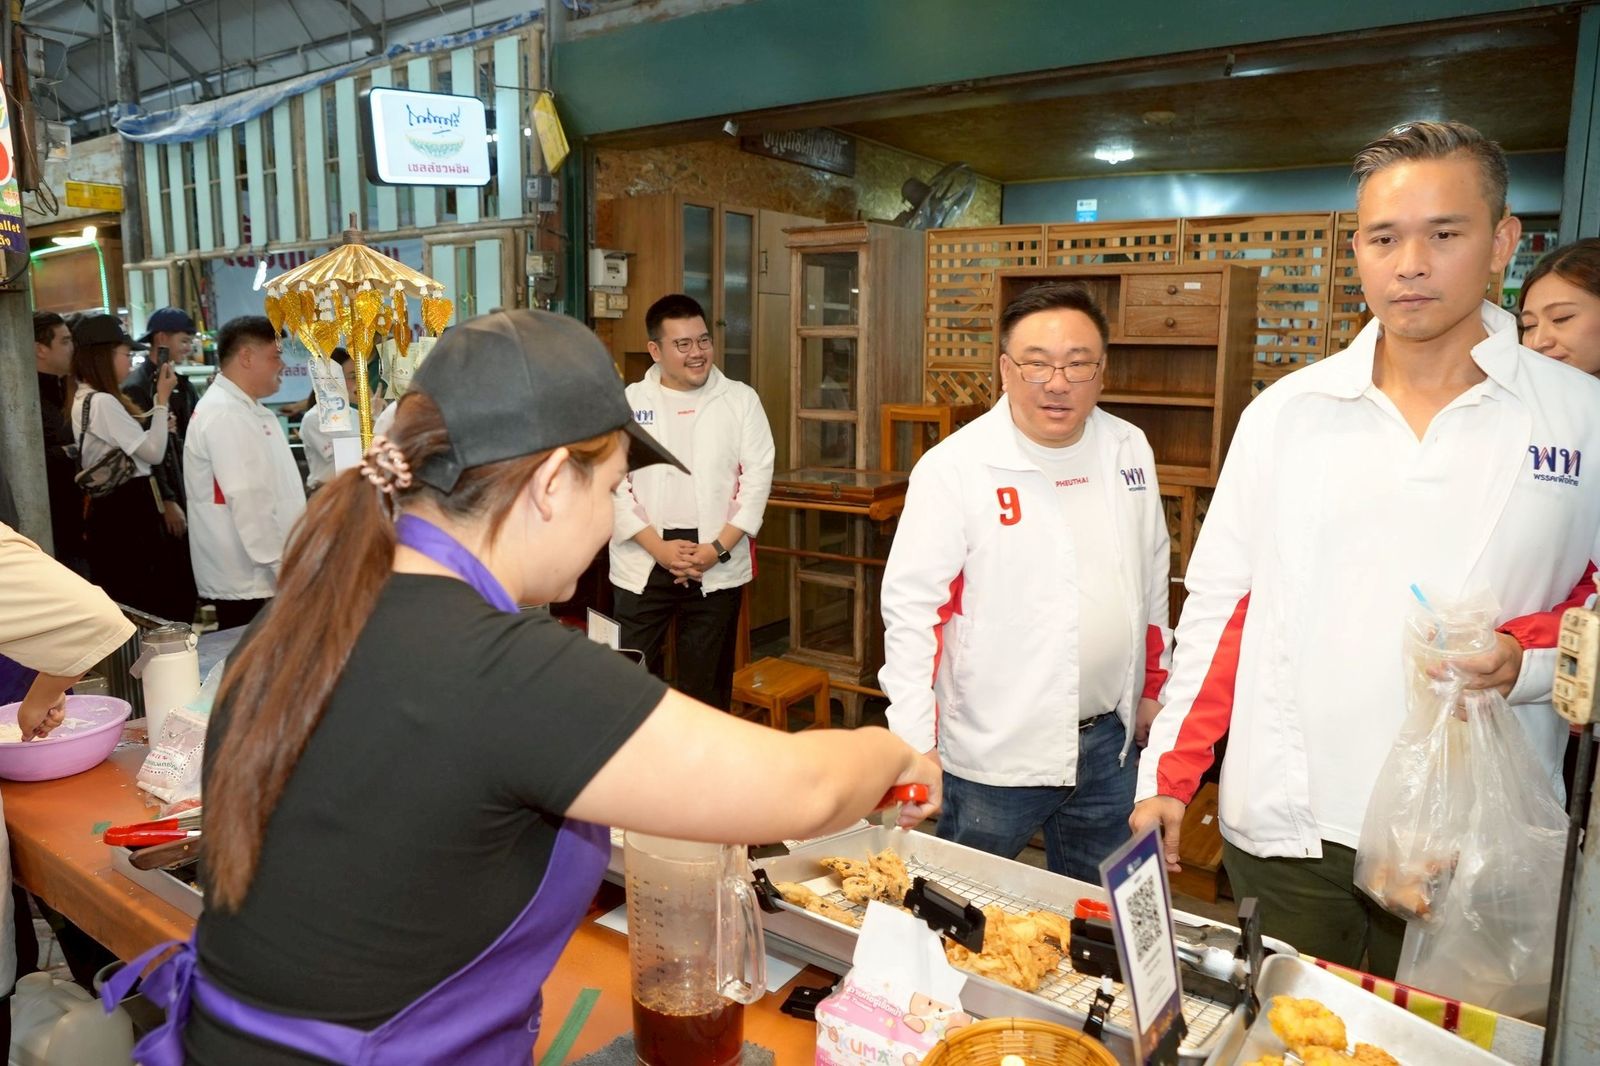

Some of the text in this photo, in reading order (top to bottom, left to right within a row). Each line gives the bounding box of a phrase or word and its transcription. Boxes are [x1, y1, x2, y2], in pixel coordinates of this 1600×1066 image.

[408, 161, 469, 173] เชลล์ชวนชิม
[1055, 476, 1089, 487] PHEUTHAI
[997, 486, 1022, 526] 9
